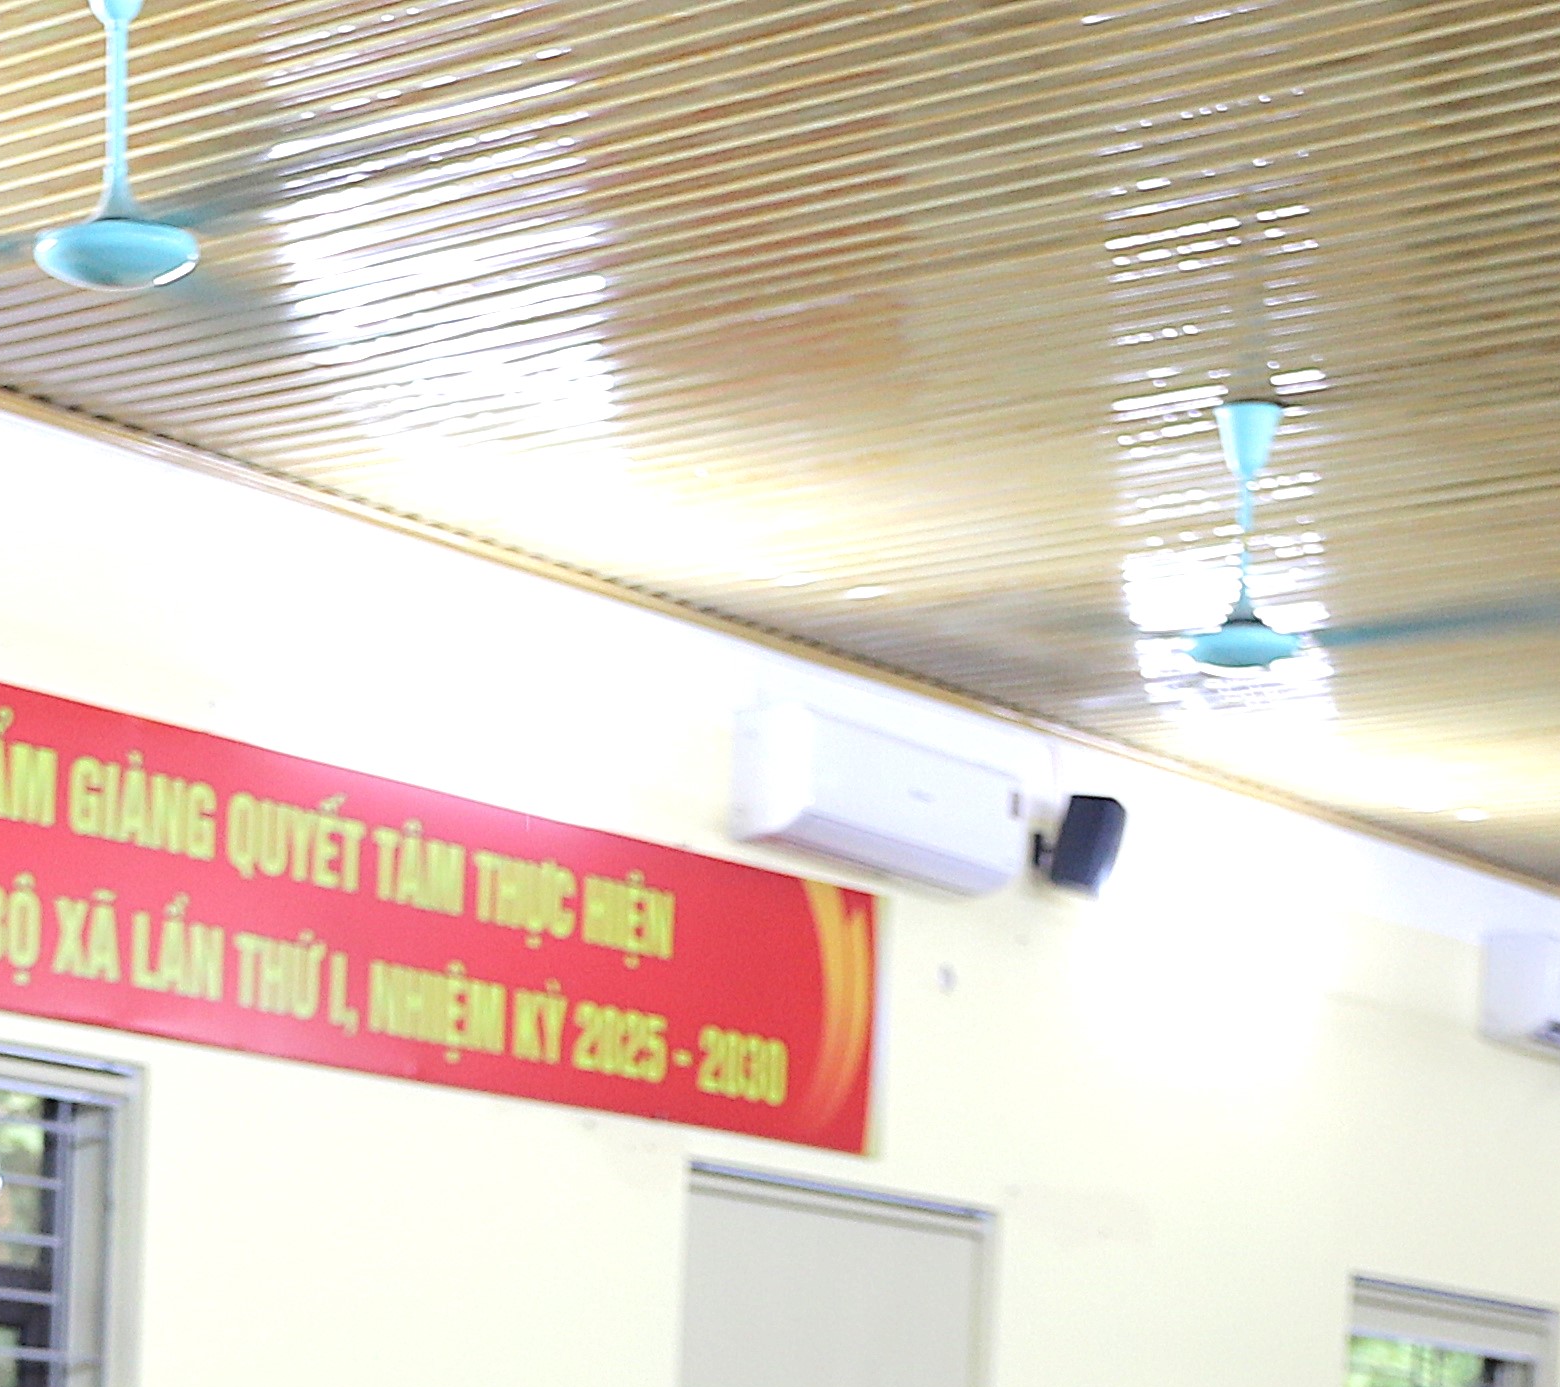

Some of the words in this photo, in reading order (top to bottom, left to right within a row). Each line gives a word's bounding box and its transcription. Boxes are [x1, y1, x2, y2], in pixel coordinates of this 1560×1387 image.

[68, 749, 217, 862] GIÀNG
[226, 792, 367, 894] QUYẾT
[372, 818, 466, 918] TÂM
[473, 849, 578, 950] THỰC
[582, 869, 677, 970] HIỆN
[52, 888, 121, 983] XÃ
[130, 892, 225, 1003] LẦN
[234, 929, 327, 1021] THỨ
[369, 959, 507, 1065] NHIỆM
[511, 978, 569, 1065] KỲ
[572, 1001, 669, 1084] 2025
[696, 1024, 788, 1108] 2030
